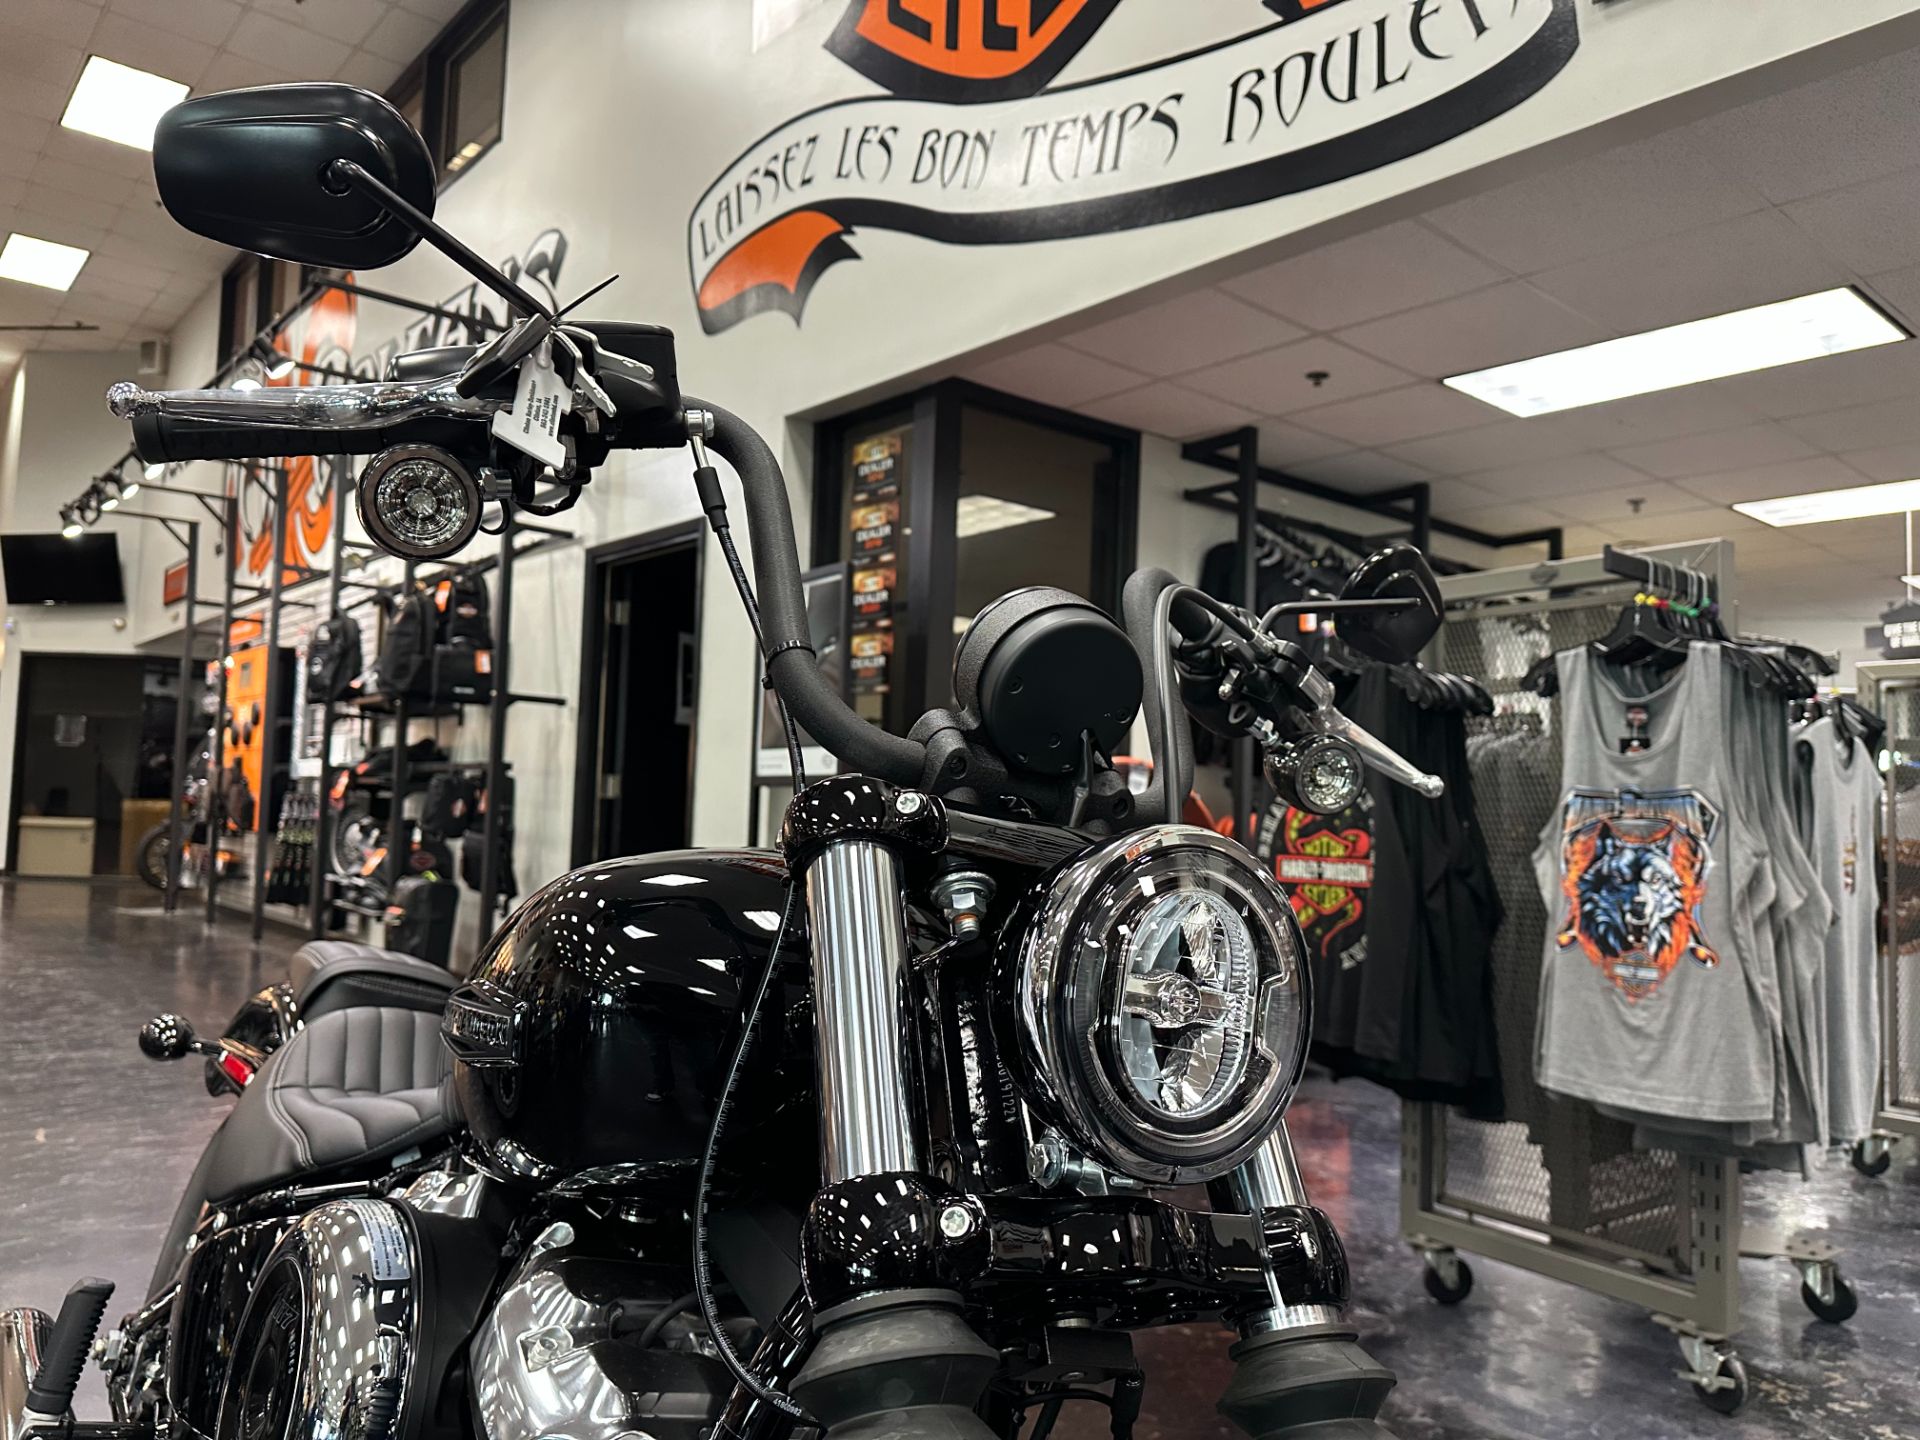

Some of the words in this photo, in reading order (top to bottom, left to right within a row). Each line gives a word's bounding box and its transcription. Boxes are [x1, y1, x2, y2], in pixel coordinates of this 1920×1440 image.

[697, 133, 820, 262] LAISSEZ
[835, 124, 898, 182] LES
[911, 127, 997, 190] BON
[1021, 92, 1184, 186] TEMPS
